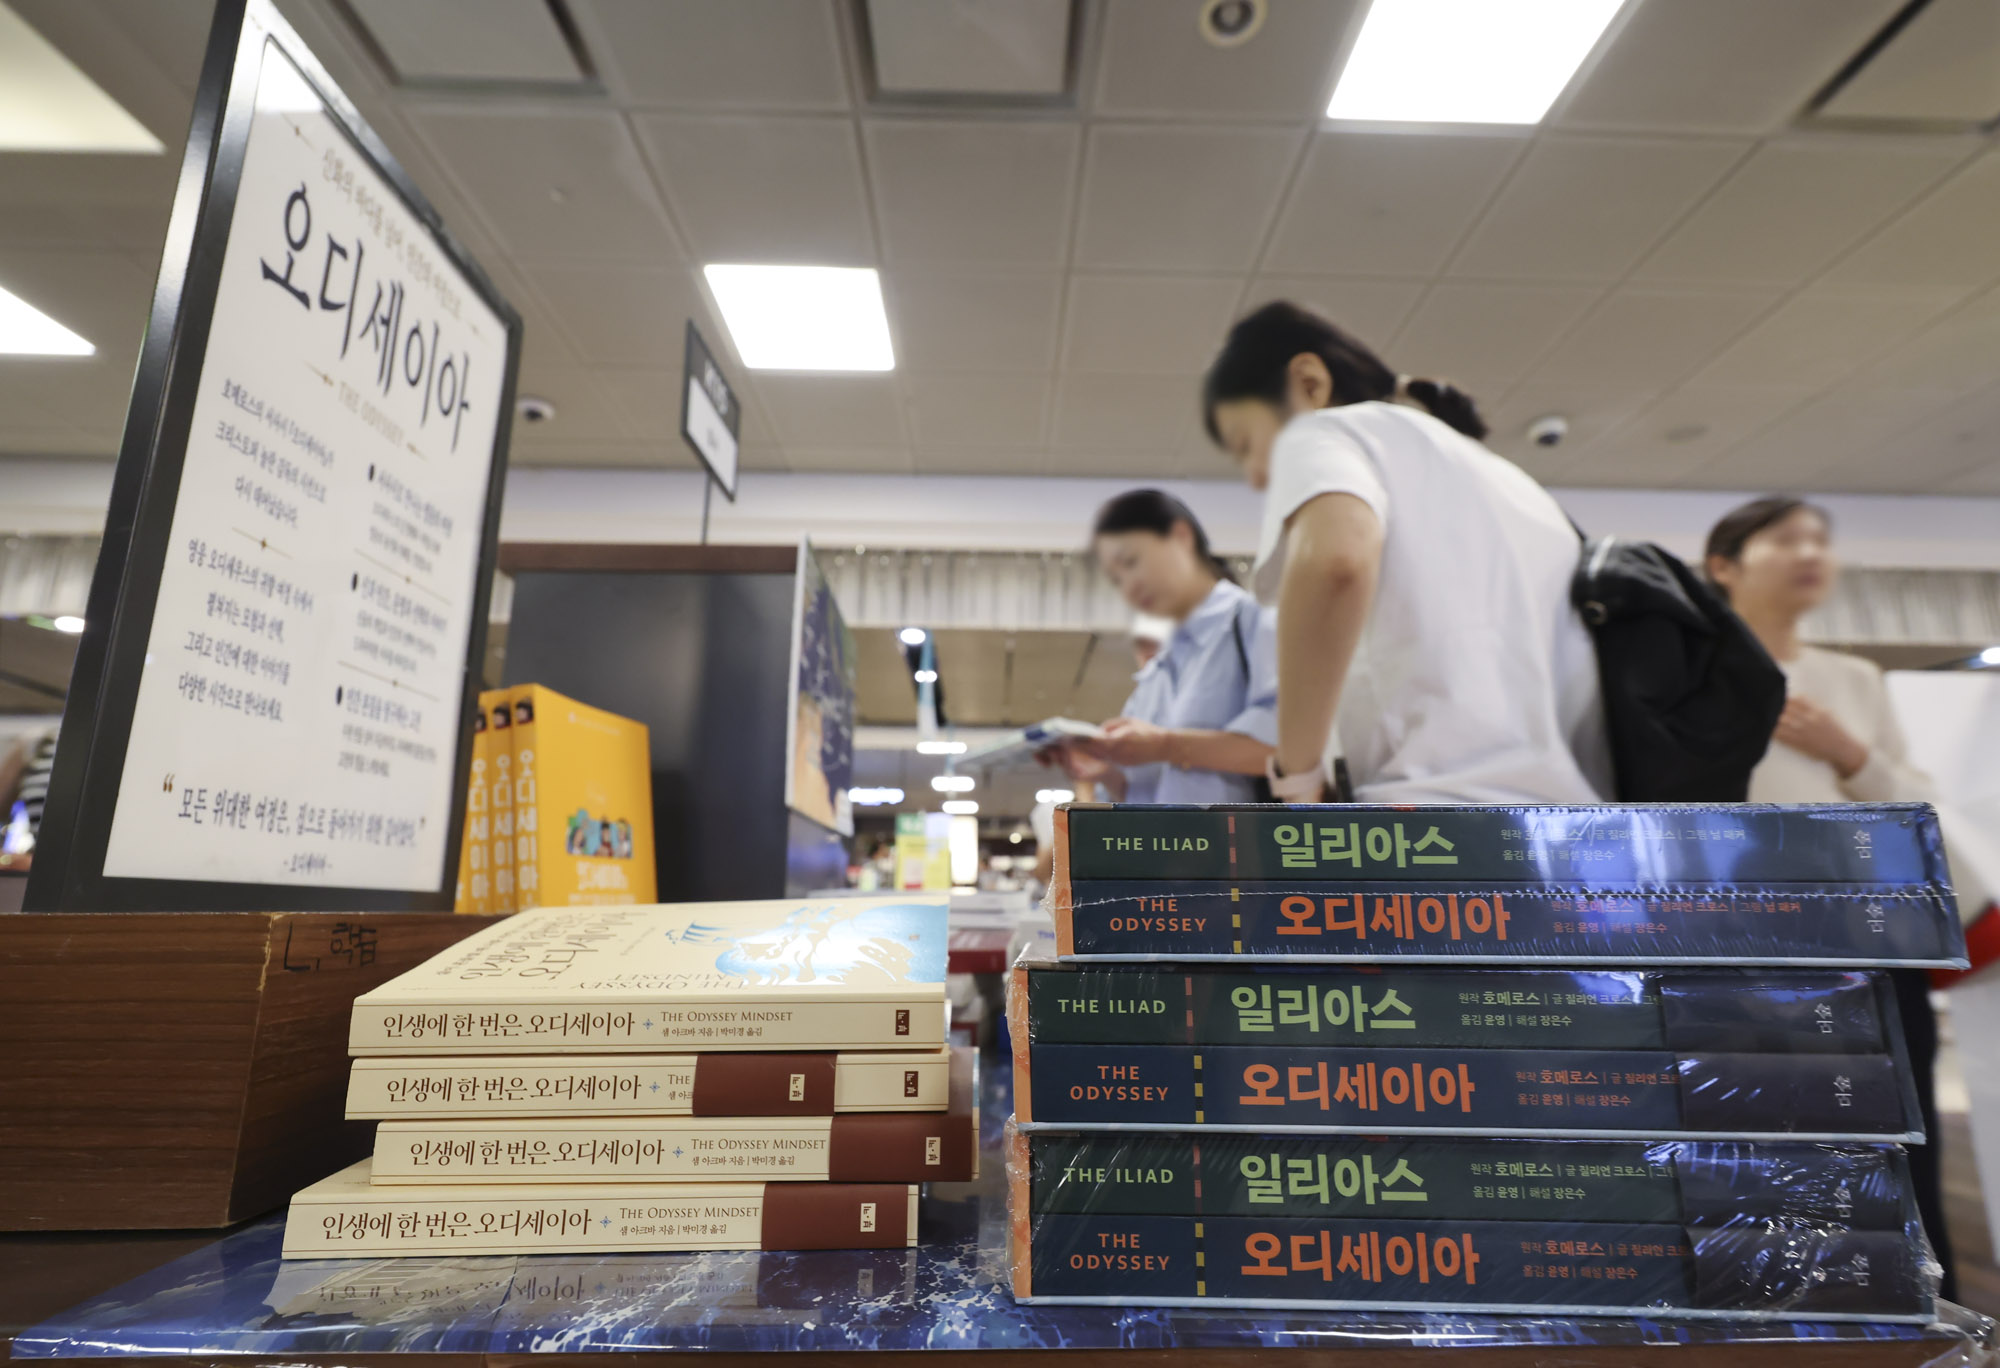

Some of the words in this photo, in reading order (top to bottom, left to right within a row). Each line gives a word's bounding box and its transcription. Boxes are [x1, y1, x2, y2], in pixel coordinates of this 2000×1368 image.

[260, 182, 470, 454] 오디세이아
[222, 379, 263, 418] 호메로스의
[216, 421, 259, 461] 크리스토퍼
[189, 539, 206, 567] 영웅
[208, 549, 259, 586] 오디세우스의
[184, 631, 213, 657] 그리고
[215, 640, 242, 668] 인간에
[242, 649, 259, 675] 대한
[178, 672, 206, 702] 다양한
[208, 682, 242, 710] 시각으로
[178, 789, 207, 824] 모든
[213, 789, 251, 829] 위대한
[296, 803, 326, 836] 집으로
[516, 749, 538, 891] 오디세이아
[1500, 829, 1522, 841] 원작
[1102, 837, 1144, 851] THE
[1153, 838, 1210, 851] ILIAD
[1273, 822, 1459, 869] 일리아스
[1136, 898, 1178, 913] THE
[1109, 917, 1207, 932] ODYSSEY
[1276, 894, 1511, 941] 오디세이아
[330, 922, 378, 967] 학습
[1058, 999, 1099, 1013] THE
[1109, 999, 1166, 1014] ILIAD
[1458, 993, 1479, 1004] 원작
[1483, 991, 1541, 1006] 호메로스
[1552, 994, 1563, 1004] 글
[1565, 994, 1597, 1005] 질리언
[1230, 984, 1416, 1032] 일리아스
[384, 1013, 448, 1038] 인생에
[452, 1013, 475, 1037] 한
[480, 1013, 523, 1037] 번은
[525, 1012, 635, 1037] 오디세이아
[1461, 1015, 1482, 1026] 옮김
[1484, 1015, 1505, 1026] 윤영
[1516, 1016, 1537, 1026] 해설
[1540, 1016, 1572, 1027] 장은수
[671, 1027, 696, 1037] 아크바
[698, 1027, 713, 1037] 지음
[720, 1027, 744, 1037] 박미경
[746, 1026, 763, 1037] 옮김
[1098, 1066, 1140, 1080] THE
[1515, 1072, 1536, 1082] 원작
[1540, 1070, 1599, 1085] 호메로스
[1625, 1073, 1657, 1084] 질리언
[387, 1076, 452, 1103] 인생에
[457, 1076, 480, 1101] 한
[484, 1076, 527, 1101] 번은
[530, 1074, 642, 1100] 오디세이아
[1070, 1086, 1170, 1101] ODYSSEY
[1239, 1062, 1476, 1113] 오디세이아
[1518, 1094, 1539, 1105] 옮김
[1599, 1095, 1631, 1106] 장은수
[410, 1140, 476, 1166] 인생에
[480, 1140, 502, 1166] 한
[507, 1140, 550, 1165] 번은
[553, 1139, 665, 1165] 오디세이아
[701, 1156, 727, 1166] 아크바
[728, 1156, 745, 1166] 지음
[752, 1156, 776, 1166] 박미경
[778, 1155, 795, 1166] 옮김
[1064, 1168, 1106, 1183] THE
[1116, 1168, 1175, 1183] ILIAD
[1470, 1163, 1492, 1175] 원작
[1495, 1162, 1553, 1178] 호메로스
[1565, 1165, 1576, 1176] 글
[1579, 1165, 1611, 1177] 질리언
[1613, 1166, 1646, 1177] 크로스
[1240, 1153, 1428, 1205] 일리아스
[1472, 1186, 1494, 1198] 옮김
[1497, 1187, 1518, 1198] 윤영
[1529, 1187, 1551, 1198] 해설
[1553, 1188, 1585, 1199] 장은수
[322, 1212, 392, 1240] 인생에
[396, 1212, 421, 1238] 한
[425, 1211, 472, 1238] 번은
[473, 1209, 592, 1236] 오디세이아
[630, 1225, 656, 1236] 아크바
[658, 1225, 675, 1235] 지음
[682, 1224, 708, 1235] 박미경
[710, 1224, 727, 1234] 옮김
[1098, 1234, 1140, 1248] THE
[1545, 1240, 1605, 1256] 호메로스
[1070, 1255, 1170, 1271] ODYSSEY
[1241, 1230, 1480, 1285] 오디세이아
